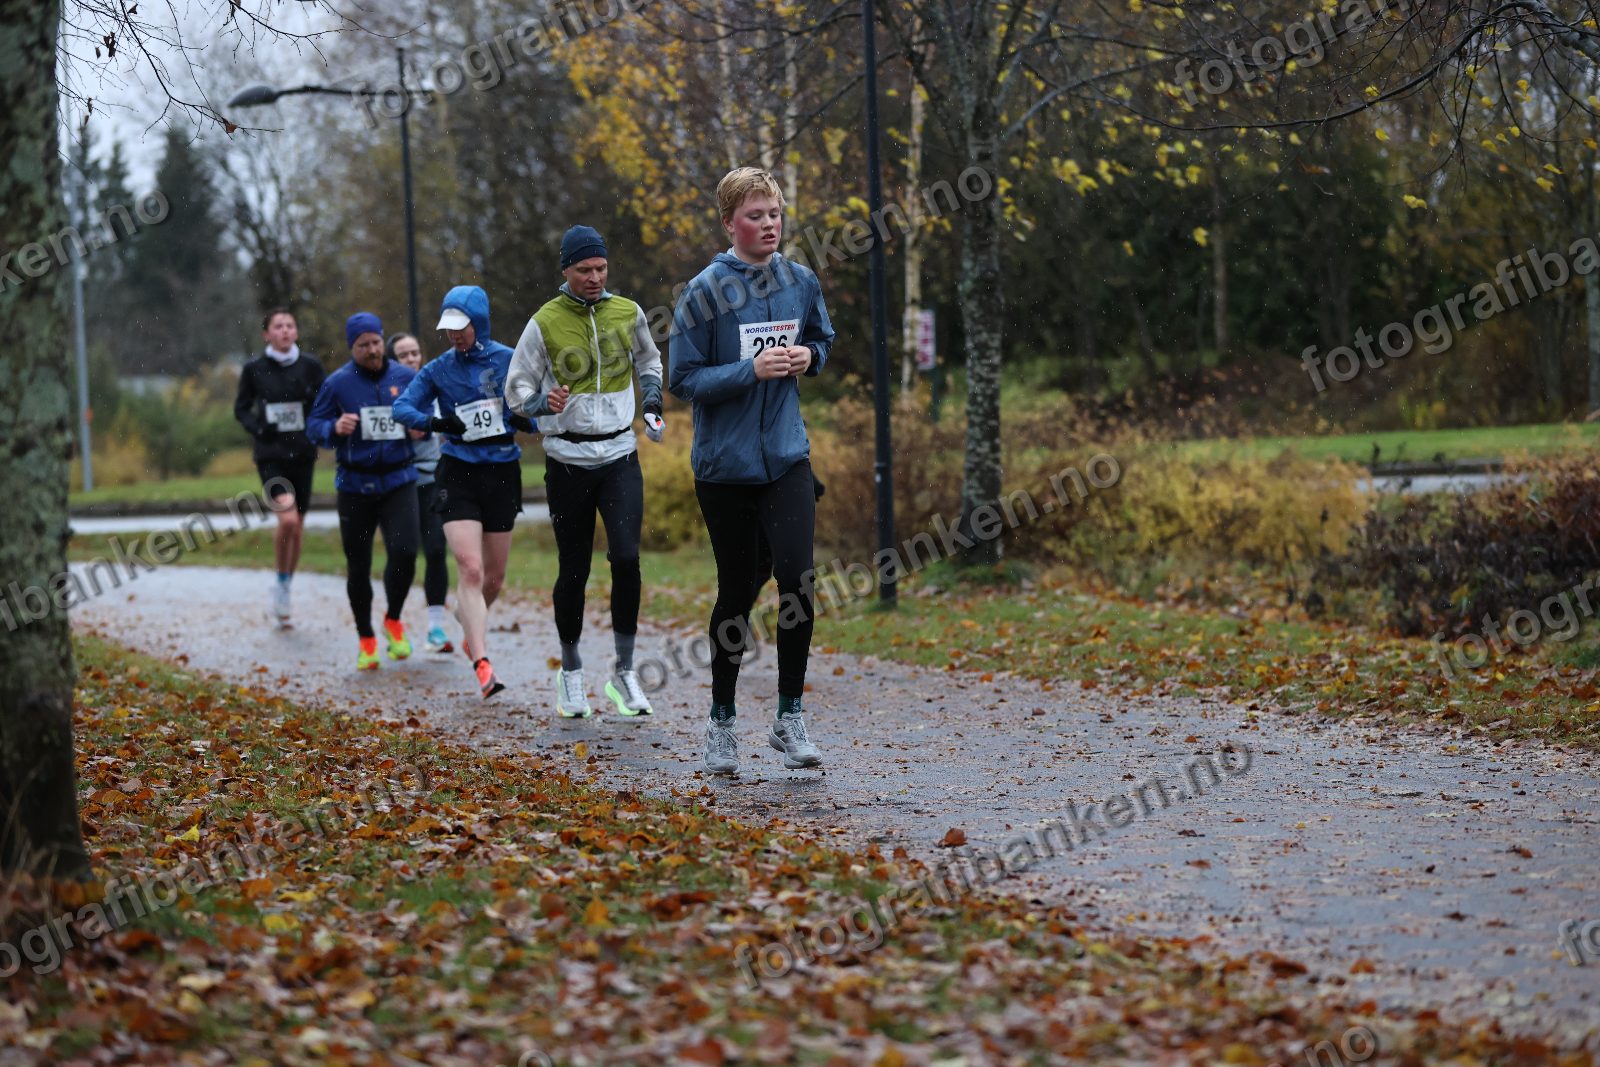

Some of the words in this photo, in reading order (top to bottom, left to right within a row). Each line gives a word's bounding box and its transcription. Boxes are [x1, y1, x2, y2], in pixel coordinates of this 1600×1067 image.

[745, 323, 796, 335] NORGESTESTEN
[370, 416, 396, 433] 769
[473, 409, 492, 428] 49
